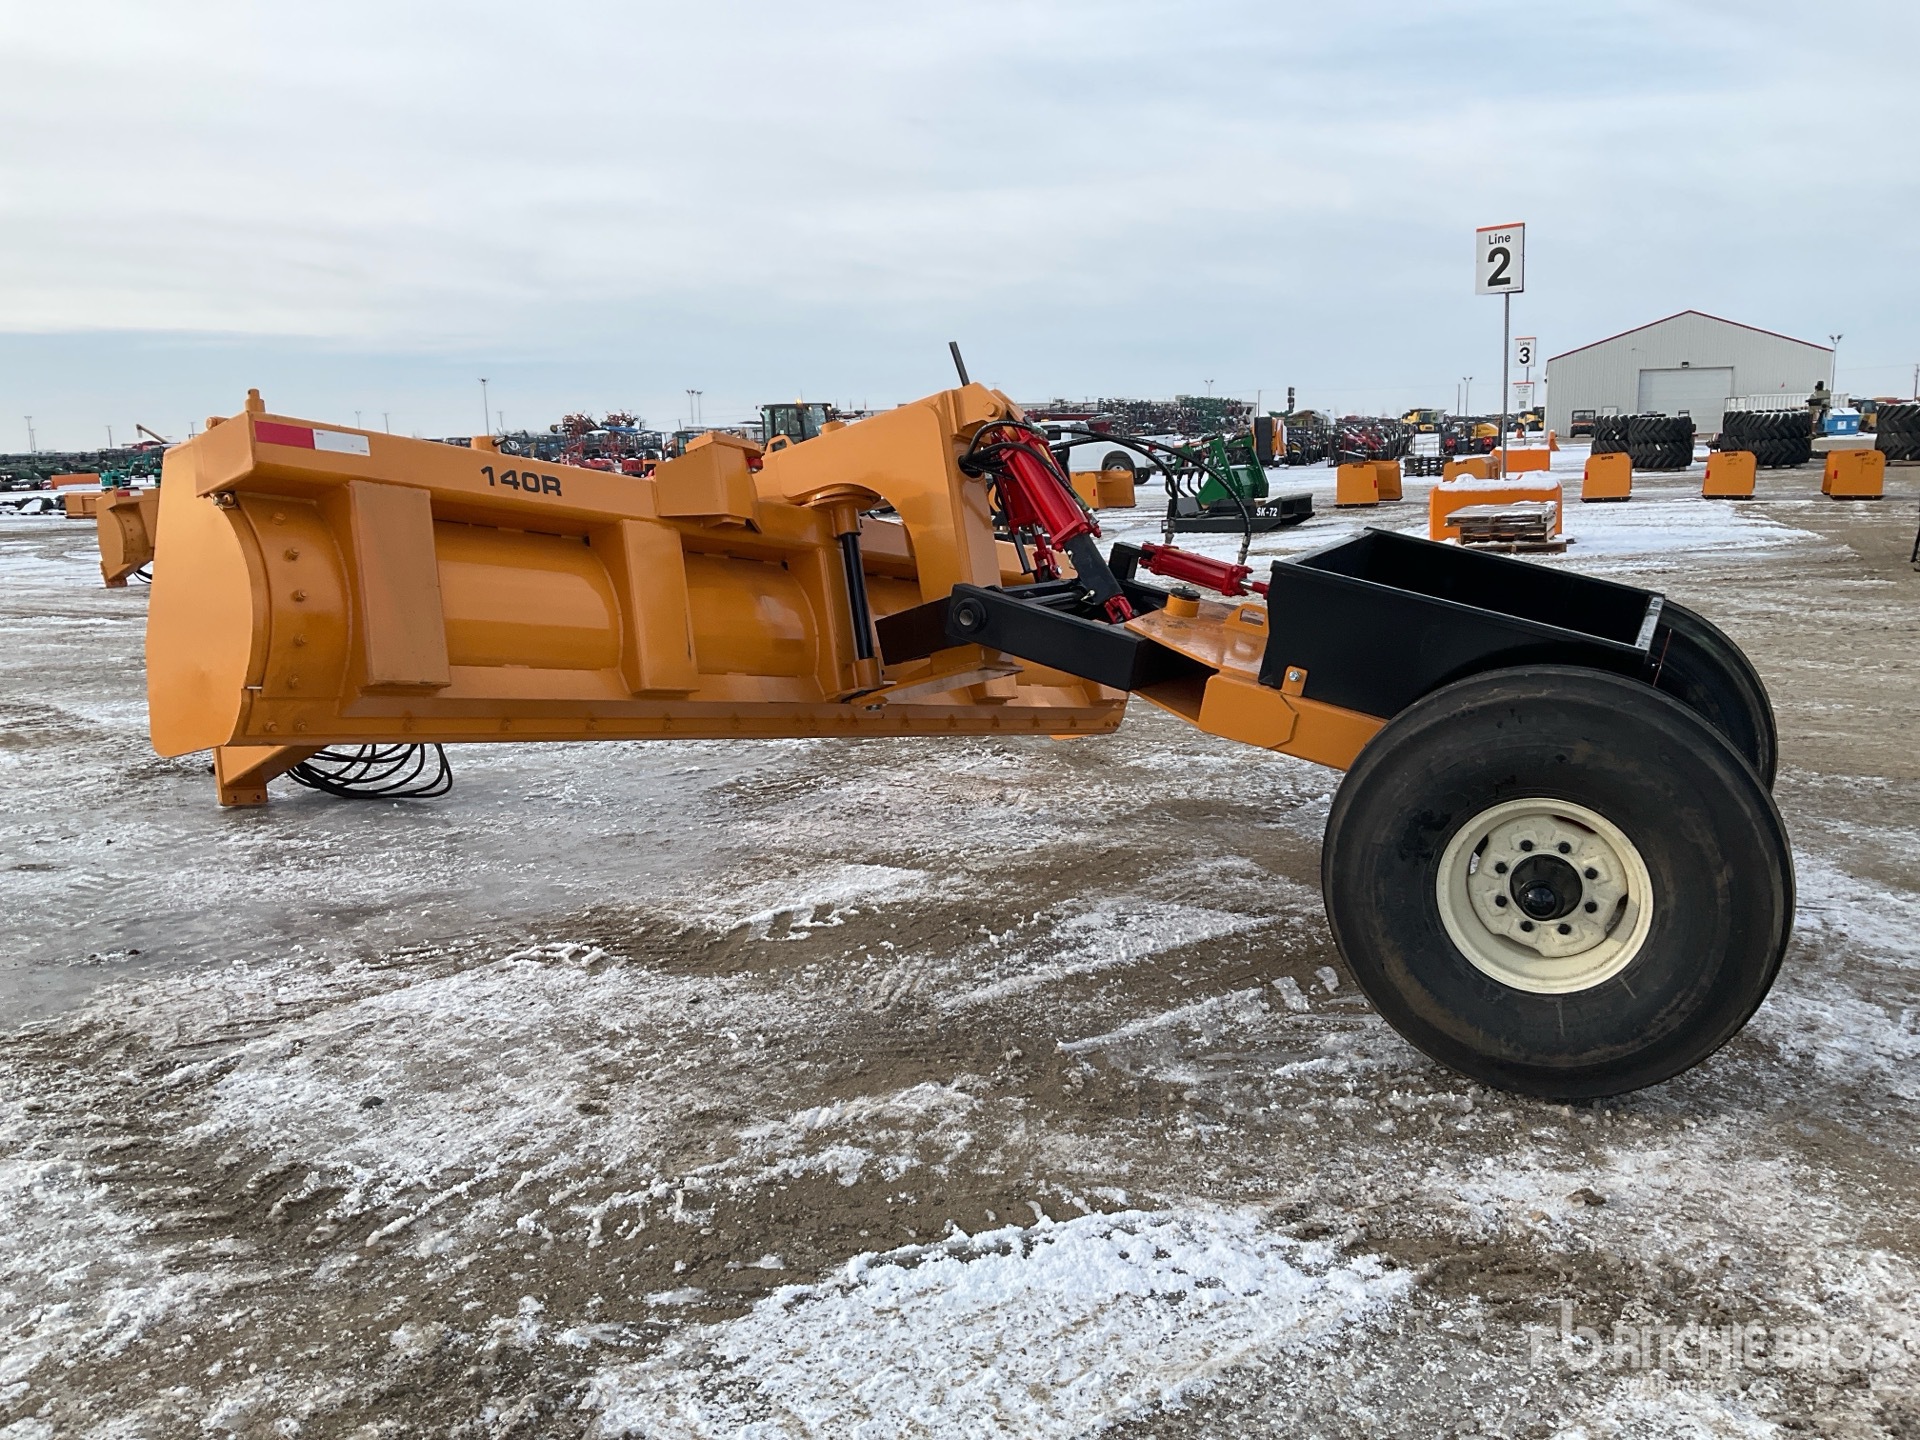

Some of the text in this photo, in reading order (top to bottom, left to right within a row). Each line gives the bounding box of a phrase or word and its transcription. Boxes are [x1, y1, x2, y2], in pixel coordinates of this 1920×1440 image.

[1488, 233, 1511, 245] Line
[1487, 246, 1511, 287] 2
[1519, 346, 1530, 364] 3
[480, 466, 562, 497] 140R
[1256, 507, 1278, 517] SK-72
